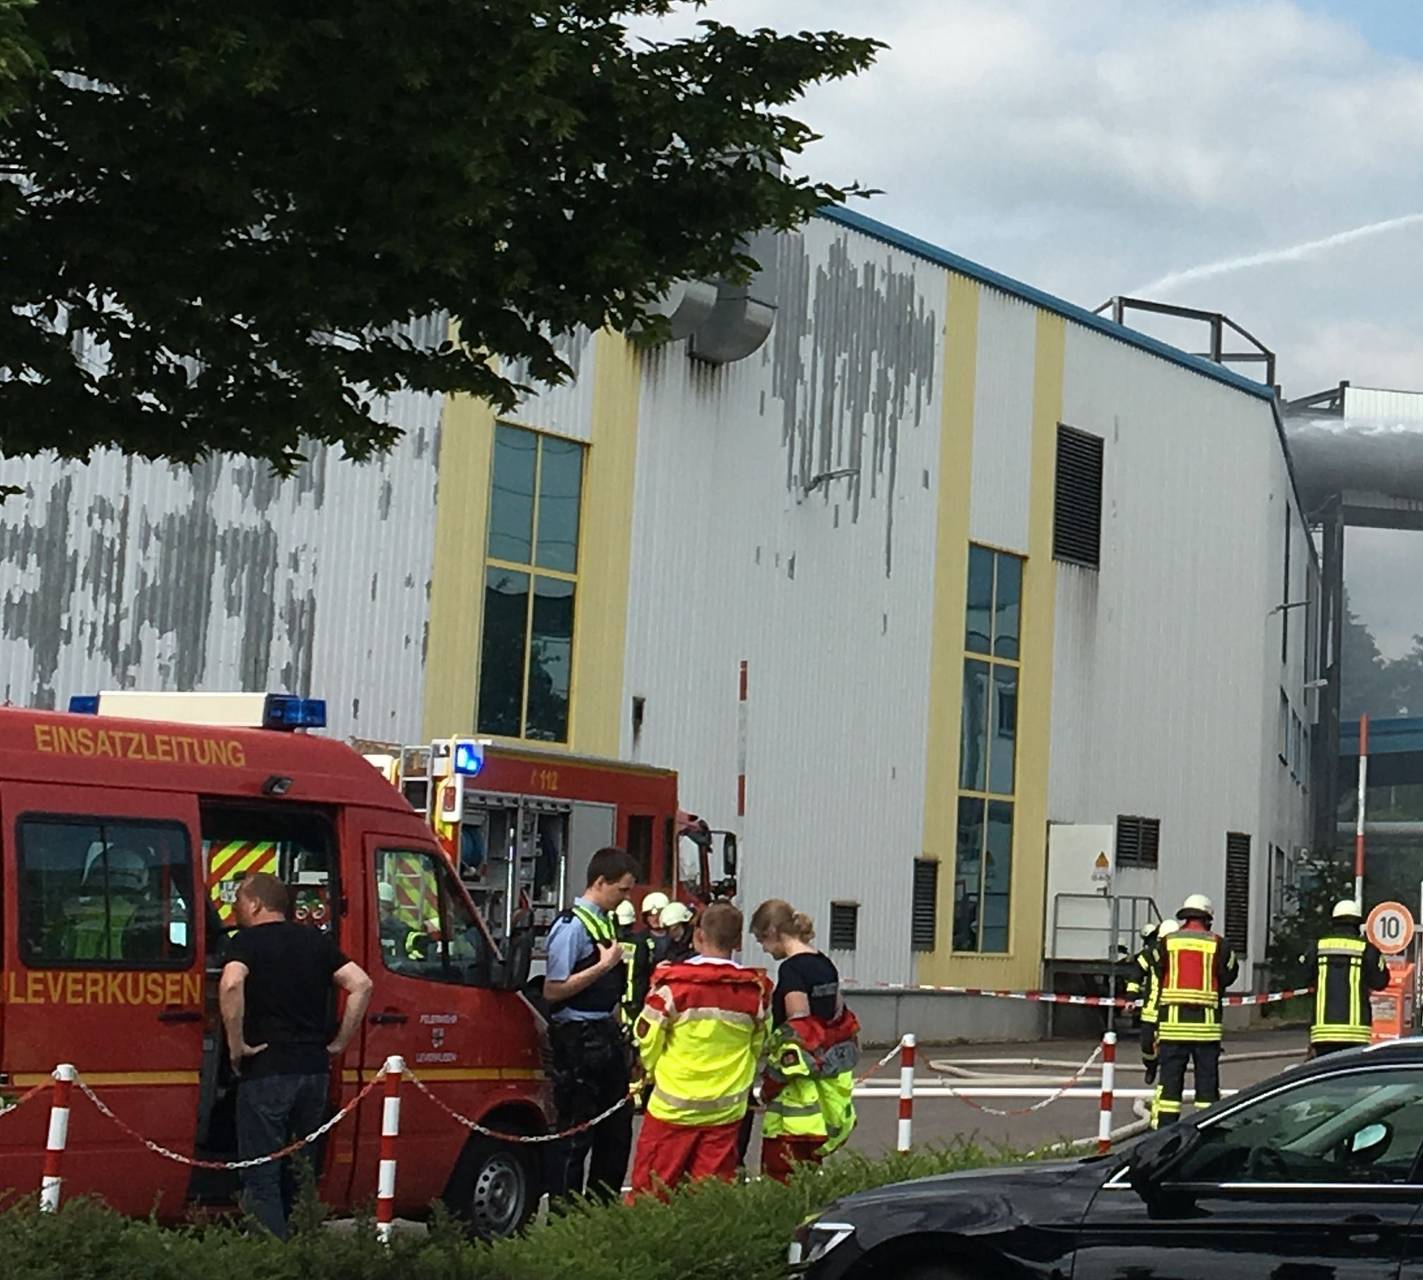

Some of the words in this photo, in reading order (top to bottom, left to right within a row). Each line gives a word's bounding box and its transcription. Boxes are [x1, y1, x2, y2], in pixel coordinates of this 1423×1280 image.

[34, 724, 246, 767] EINSATZLEITUNG
[1380, 916, 1399, 939] 10
[9, 972, 200, 1004] LEVERKUSEN
